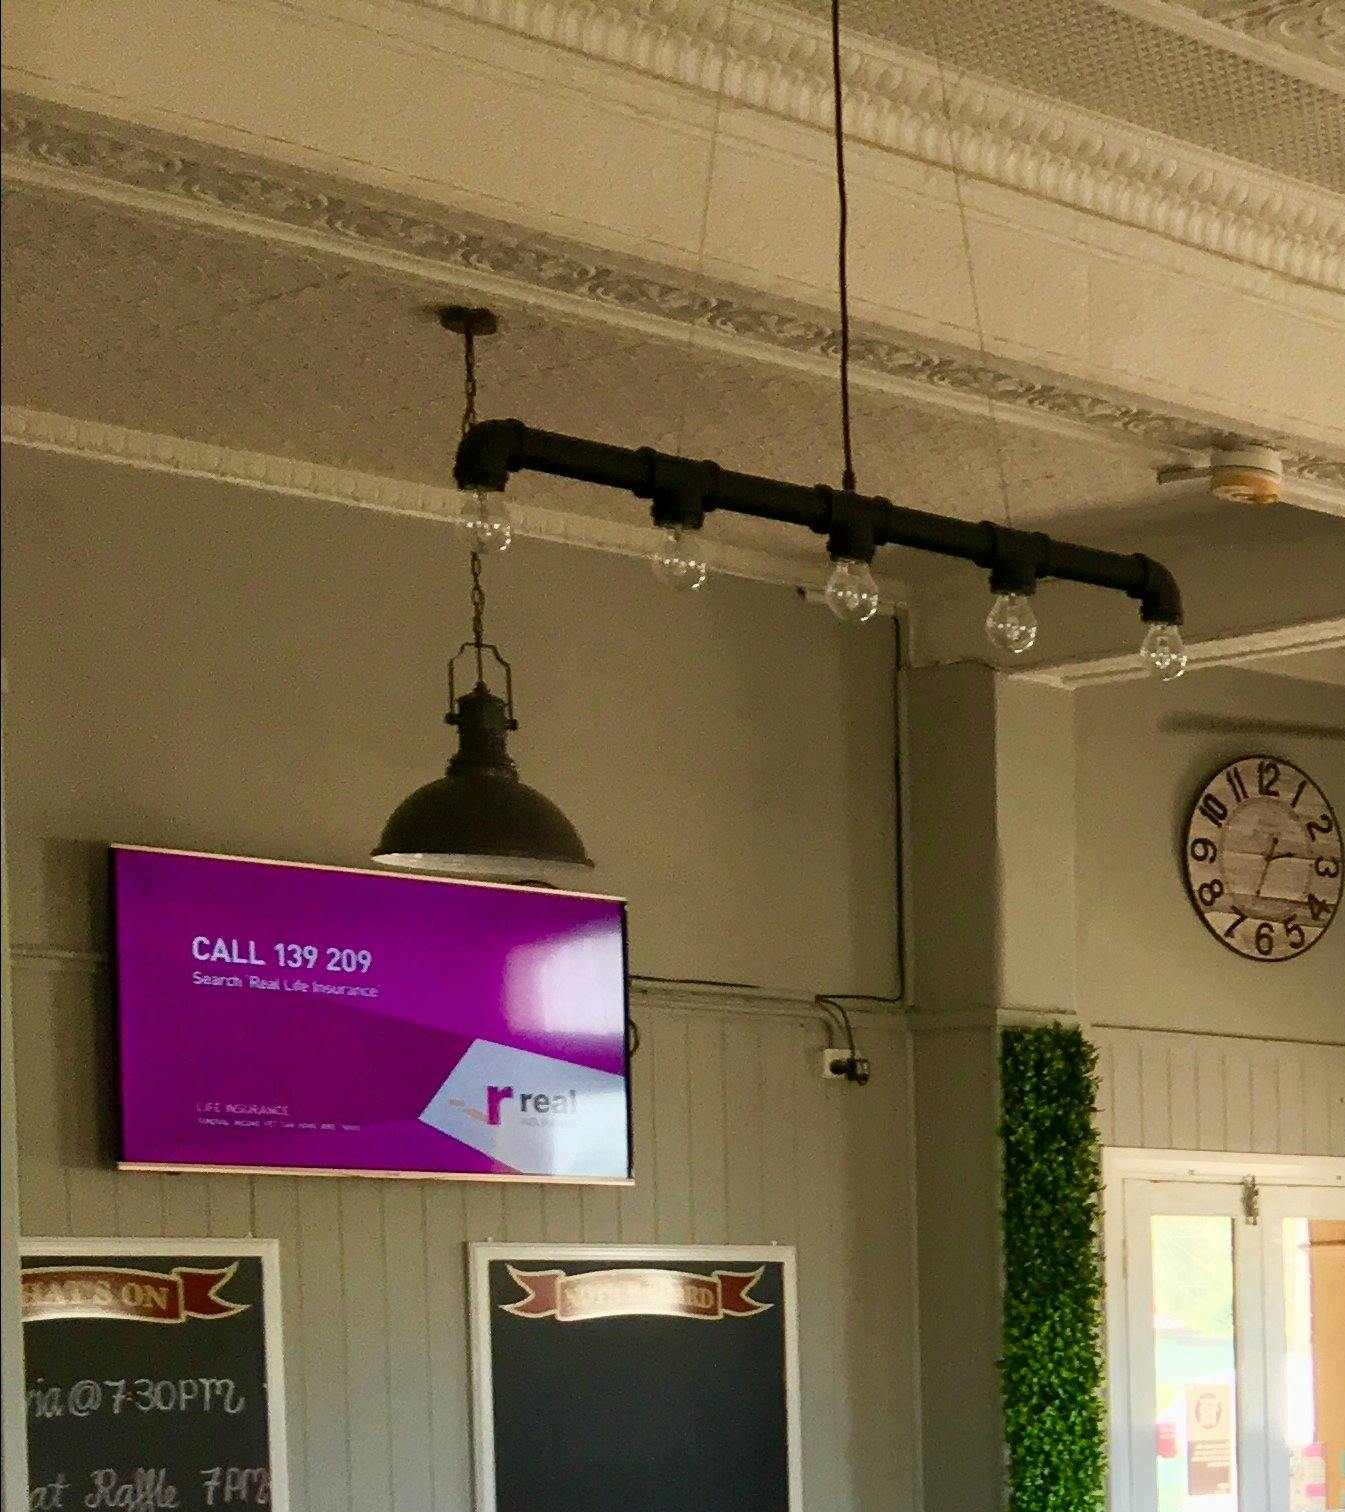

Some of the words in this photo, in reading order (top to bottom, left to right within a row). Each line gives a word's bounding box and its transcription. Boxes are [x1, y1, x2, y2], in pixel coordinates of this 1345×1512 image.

[1226, 767, 1249, 802] 11
[1257, 761, 1280, 797] 12
[1290, 780, 1307, 808] 1
[1199, 793, 1228, 827] 10
[1306, 814, 1333, 842] 2
[1190, 837, 1217, 864] 9
[1314, 856, 1339, 878] 3
[1198, 879, 1223, 906] 8
[1308, 893, 1330, 921] 4
[1223, 905, 1248, 938] 7
[1284, 914, 1305, 949] 5
[1255, 922, 1274, 955] 6
[192, 936, 266, 966] CALL
[274, 943, 318, 969] 139
[326, 947, 372, 973] 209
[120, 1282, 169, 1310] ON
